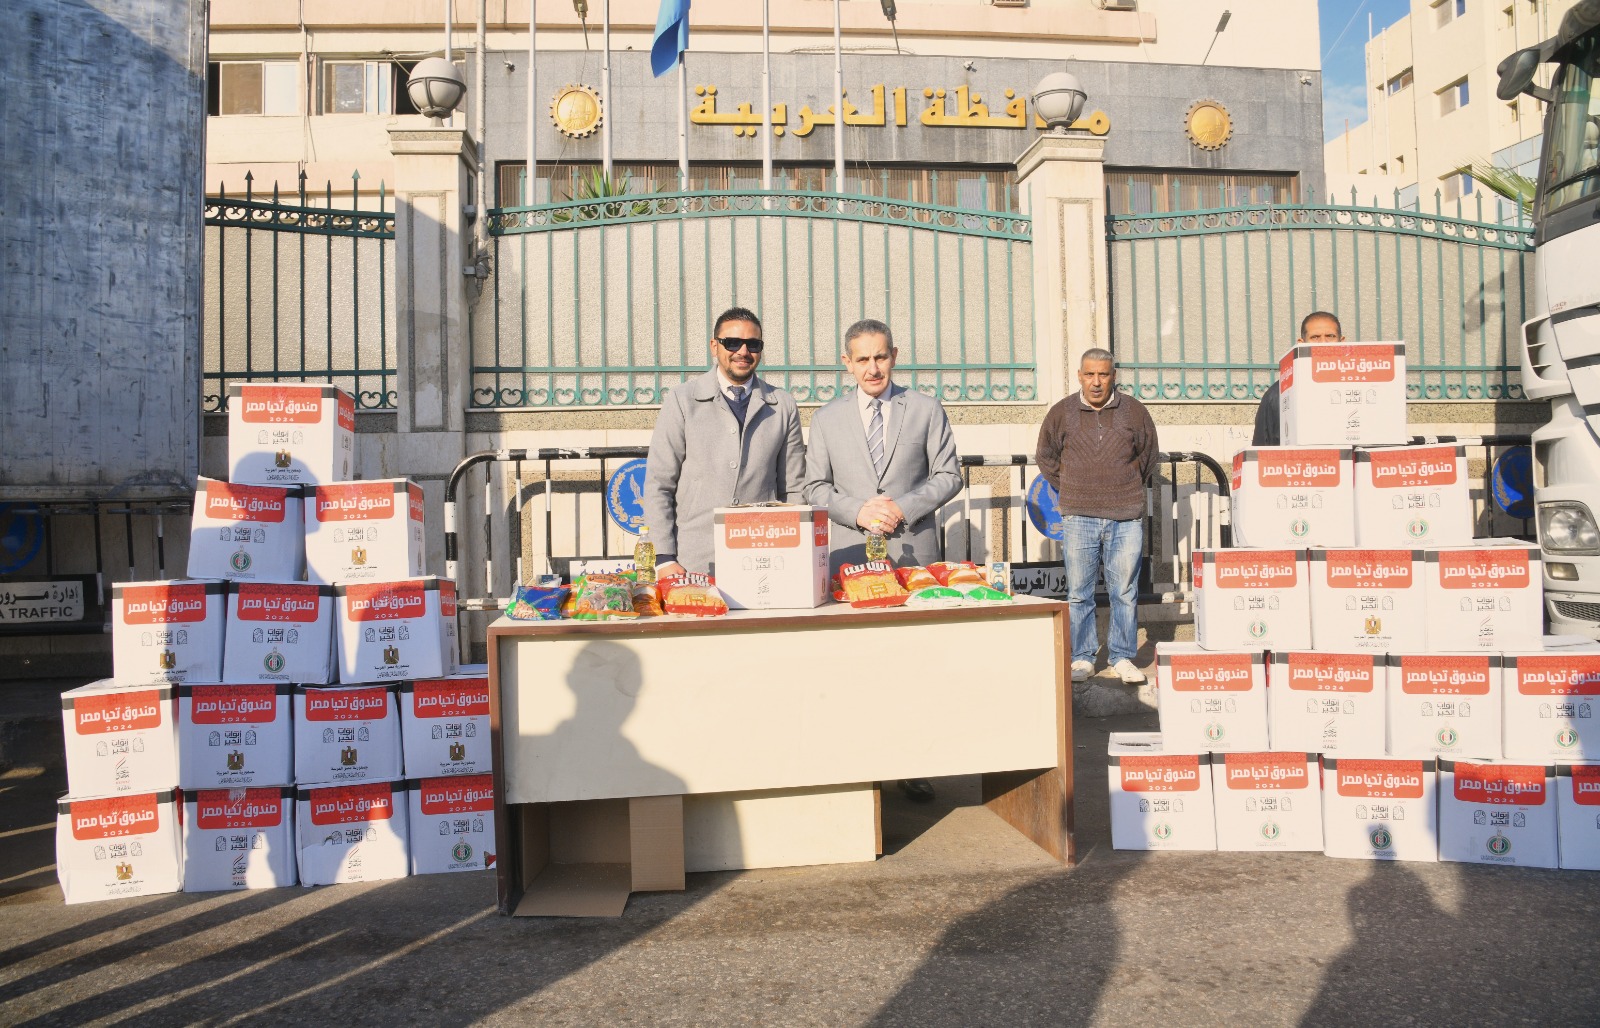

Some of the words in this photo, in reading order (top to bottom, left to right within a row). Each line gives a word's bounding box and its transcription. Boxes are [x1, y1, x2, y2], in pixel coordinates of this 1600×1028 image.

[690, 84, 906, 136] الغربية
[921, 85, 1110, 135] مفظة
[1315, 361, 1336, 372] مصر
[1337, 358, 1355, 372] تحيا
[1356, 358, 1390, 372] صندوق
[245, 402, 266, 413] مصر
[266, 399, 284, 413] تحيا
[285, 400, 318, 414] صندوق
[1262, 466, 1282, 477] مصر
[1283, 463, 1301, 477] تحيا
[1302, 463, 1336, 478] صندوق
[1376, 466, 1397, 478] مصر
[1398, 462, 1416, 477] تحيا
[1418, 461, 1452, 476] صندوق
[209, 497, 229, 508] مصر
[229, 496, 246, 510] تحيا
[248, 497, 281, 512] صندوق
[320, 500, 339, 511] مصر
[340, 497, 357, 511] تحيا
[358, 496, 390, 511] صندوق
[729, 528, 747, 539] مصر
[748, 525, 764, 539] تحيا
[765, 524, 796, 539] صندوق
[1220, 567, 1240, 578] مصر
[1240, 564, 1258, 578] تحيا
[1259, 564, 1293, 579] صندوق
[1331, 566, 1352, 578] مصر
[1353, 562, 1372, 578] تحيا
[1372, 564, 1408, 578] صندوق
[1444, 567, 1466, 578] مصر
[1467, 563, 1486, 578] تحيا
[1487, 563, 1525, 578] صندوق
[52, 584, 78, 603] إدارة
[127, 602, 148, 614] مصر
[149, 599, 167, 614] تحيا
[168, 599, 202, 613] صندوق
[242, 599, 262, 609] مصر
[263, 597, 281, 611] تحيا
[281, 597, 314, 612] صندوق
[351, 599, 370, 612] مصر
[371, 596, 389, 610] تحيا
[389, 595, 421, 609] صندوق
[8, 606, 72, 618] TRAFFIC
[1176, 671, 1195, 681] مصر
[1196, 667, 1214, 682] تحيا
[1215, 667, 1248, 682] صندوق
[1293, 668, 1314, 680] مصر
[1314, 666, 1333, 681] تحيا
[1334, 667, 1369, 682] صندوق
[1406, 672, 1428, 683] مصر
[1429, 669, 1448, 684] تحيا
[1449, 669, 1486, 684] صندوق
[1522, 673, 1545, 684] مصر
[1546, 669, 1566, 685] تحيا
[218, 699, 236, 713] تحيا
[237, 698, 272, 713] صندوق
[310, 700, 330, 711] مصر
[331, 697, 348, 710] تحيا
[349, 695, 382, 710] صندوق
[418, 696, 437, 708] مصر
[438, 693, 455, 707] تحيا
[456, 692, 489, 706] صندوق
[102, 707, 120, 722] تحيا
[121, 705, 156, 721] صندوق
[196, 702, 216, 713] مصر
[80, 712, 100, 724] مصر
[1125, 771, 1144, 782] مصر
[1144, 768, 1162, 782] تحيا
[1163, 768, 1196, 782] صندوق
[1230, 768, 1250, 779] مصر
[1251, 765, 1269, 780] تحيا
[1270, 765, 1304, 780] صندوق
[1341, 775, 1362, 786] مصر
[1363, 773, 1382, 788] تحيا
[1383, 773, 1419, 788] صندوق
[1459, 779, 1481, 790] مصر
[1483, 779, 1502, 793] تحيا
[1504, 779, 1541, 794] صندوق
[425, 793, 444, 804] مصر
[445, 789, 462, 804] تحيا
[224, 803, 242, 818] تحيا
[243, 803, 277, 818] صندوق
[315, 803, 335, 815] مصر
[336, 798, 353, 813] تحيا
[355, 798, 388, 812] صندوق
[99, 811, 118, 828] تحيا
[119, 809, 154, 826] صندوق
[202, 807, 222, 818] مصر
[76, 817, 98, 830] مصر
